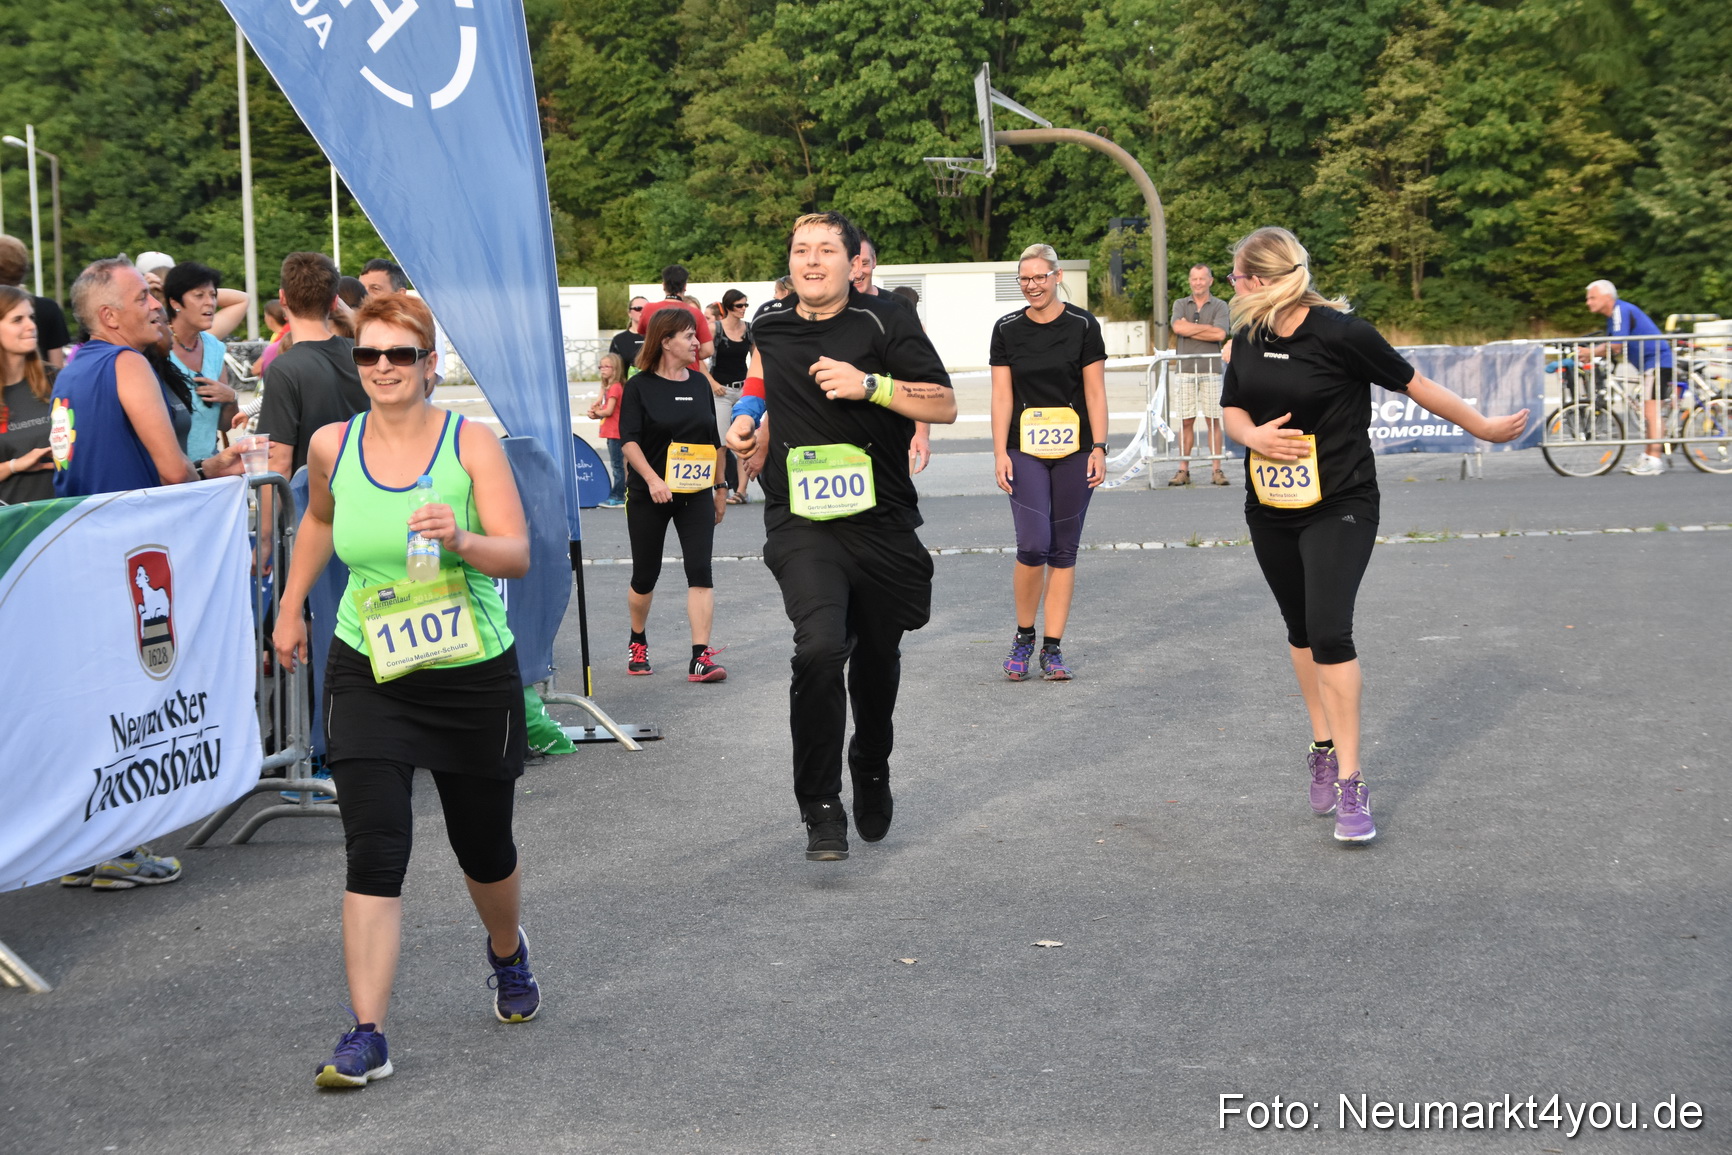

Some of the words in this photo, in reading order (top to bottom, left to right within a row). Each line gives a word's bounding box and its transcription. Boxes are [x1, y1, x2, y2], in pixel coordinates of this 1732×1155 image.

[1027, 428, 1074, 445] 1232
[672, 463, 711, 480] 1234
[1256, 465, 1311, 488] 1233
[797, 473, 865, 500] 1200
[377, 606, 462, 652] 1107
[148, 646, 169, 667] 1628
[386, 653, 414, 668] Cornelia
